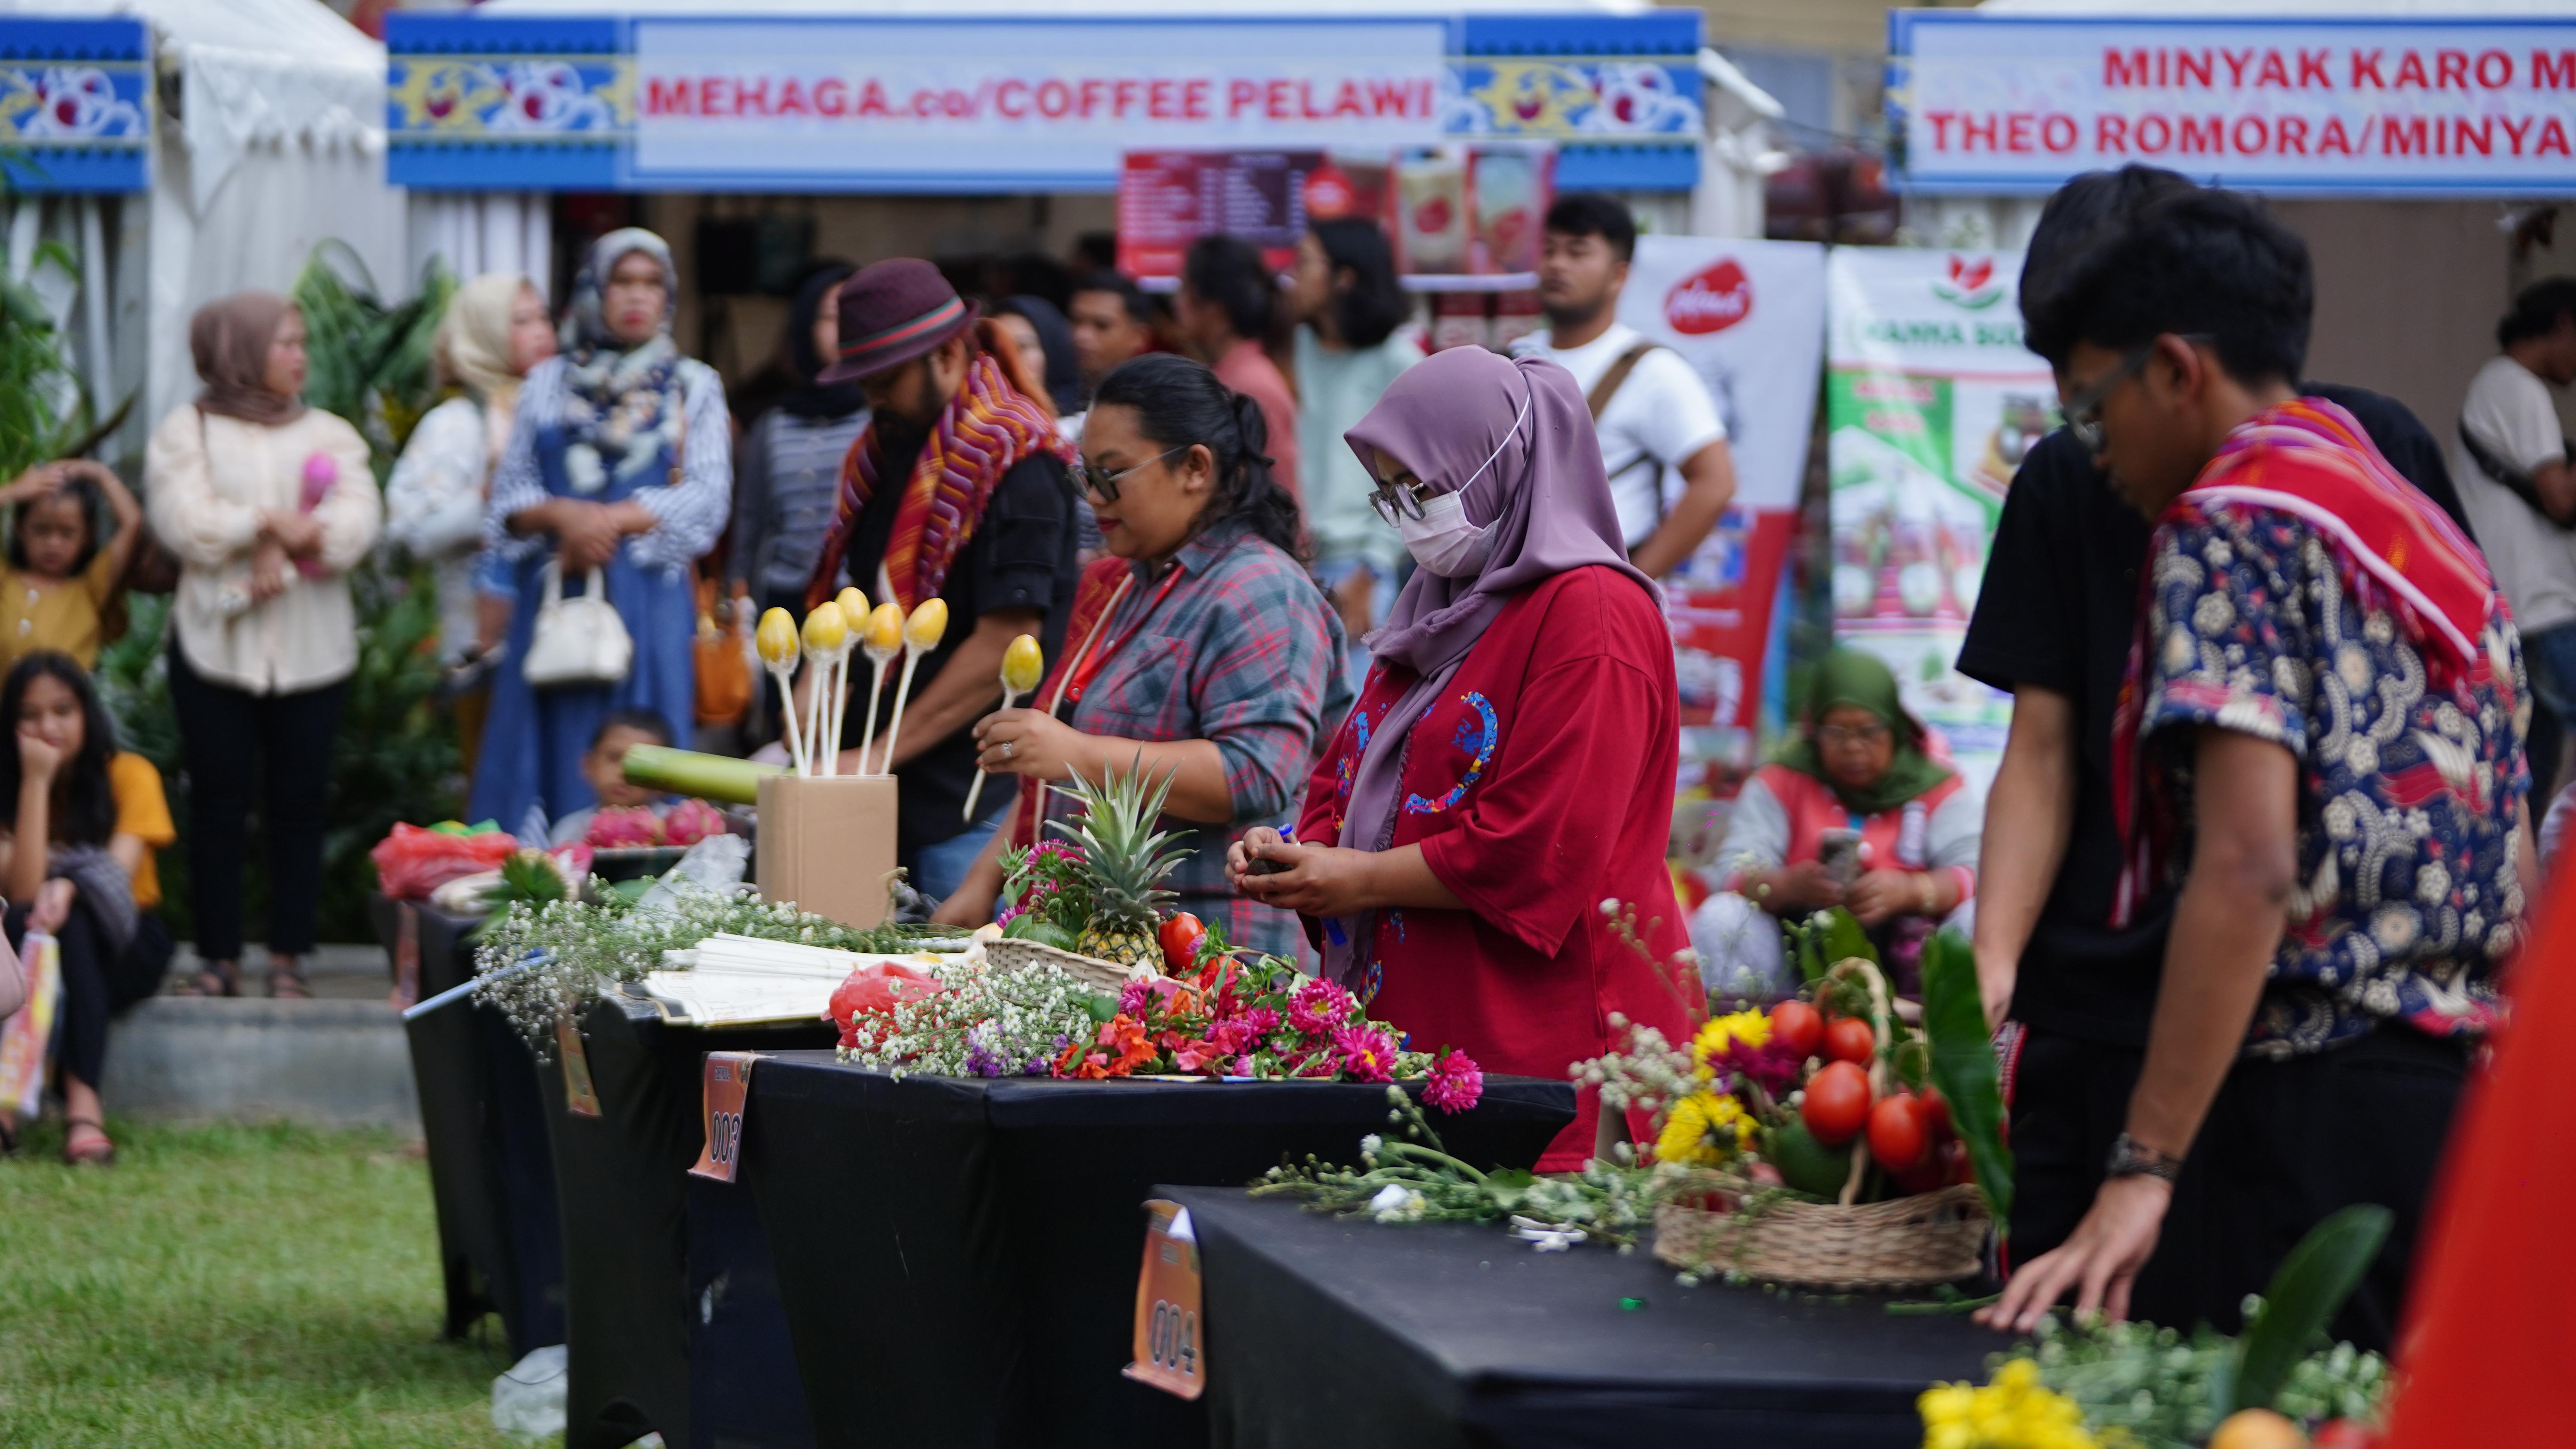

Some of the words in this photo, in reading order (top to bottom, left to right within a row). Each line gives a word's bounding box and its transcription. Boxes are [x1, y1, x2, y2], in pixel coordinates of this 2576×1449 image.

[2100, 46, 2334, 91] MINYAK
[2349, 46, 2515, 91] KARO
[1229, 76, 1434, 119] PELAWI
[1924, 110, 2080, 155] THEO
[1150, 1299, 1198, 1376] 004
